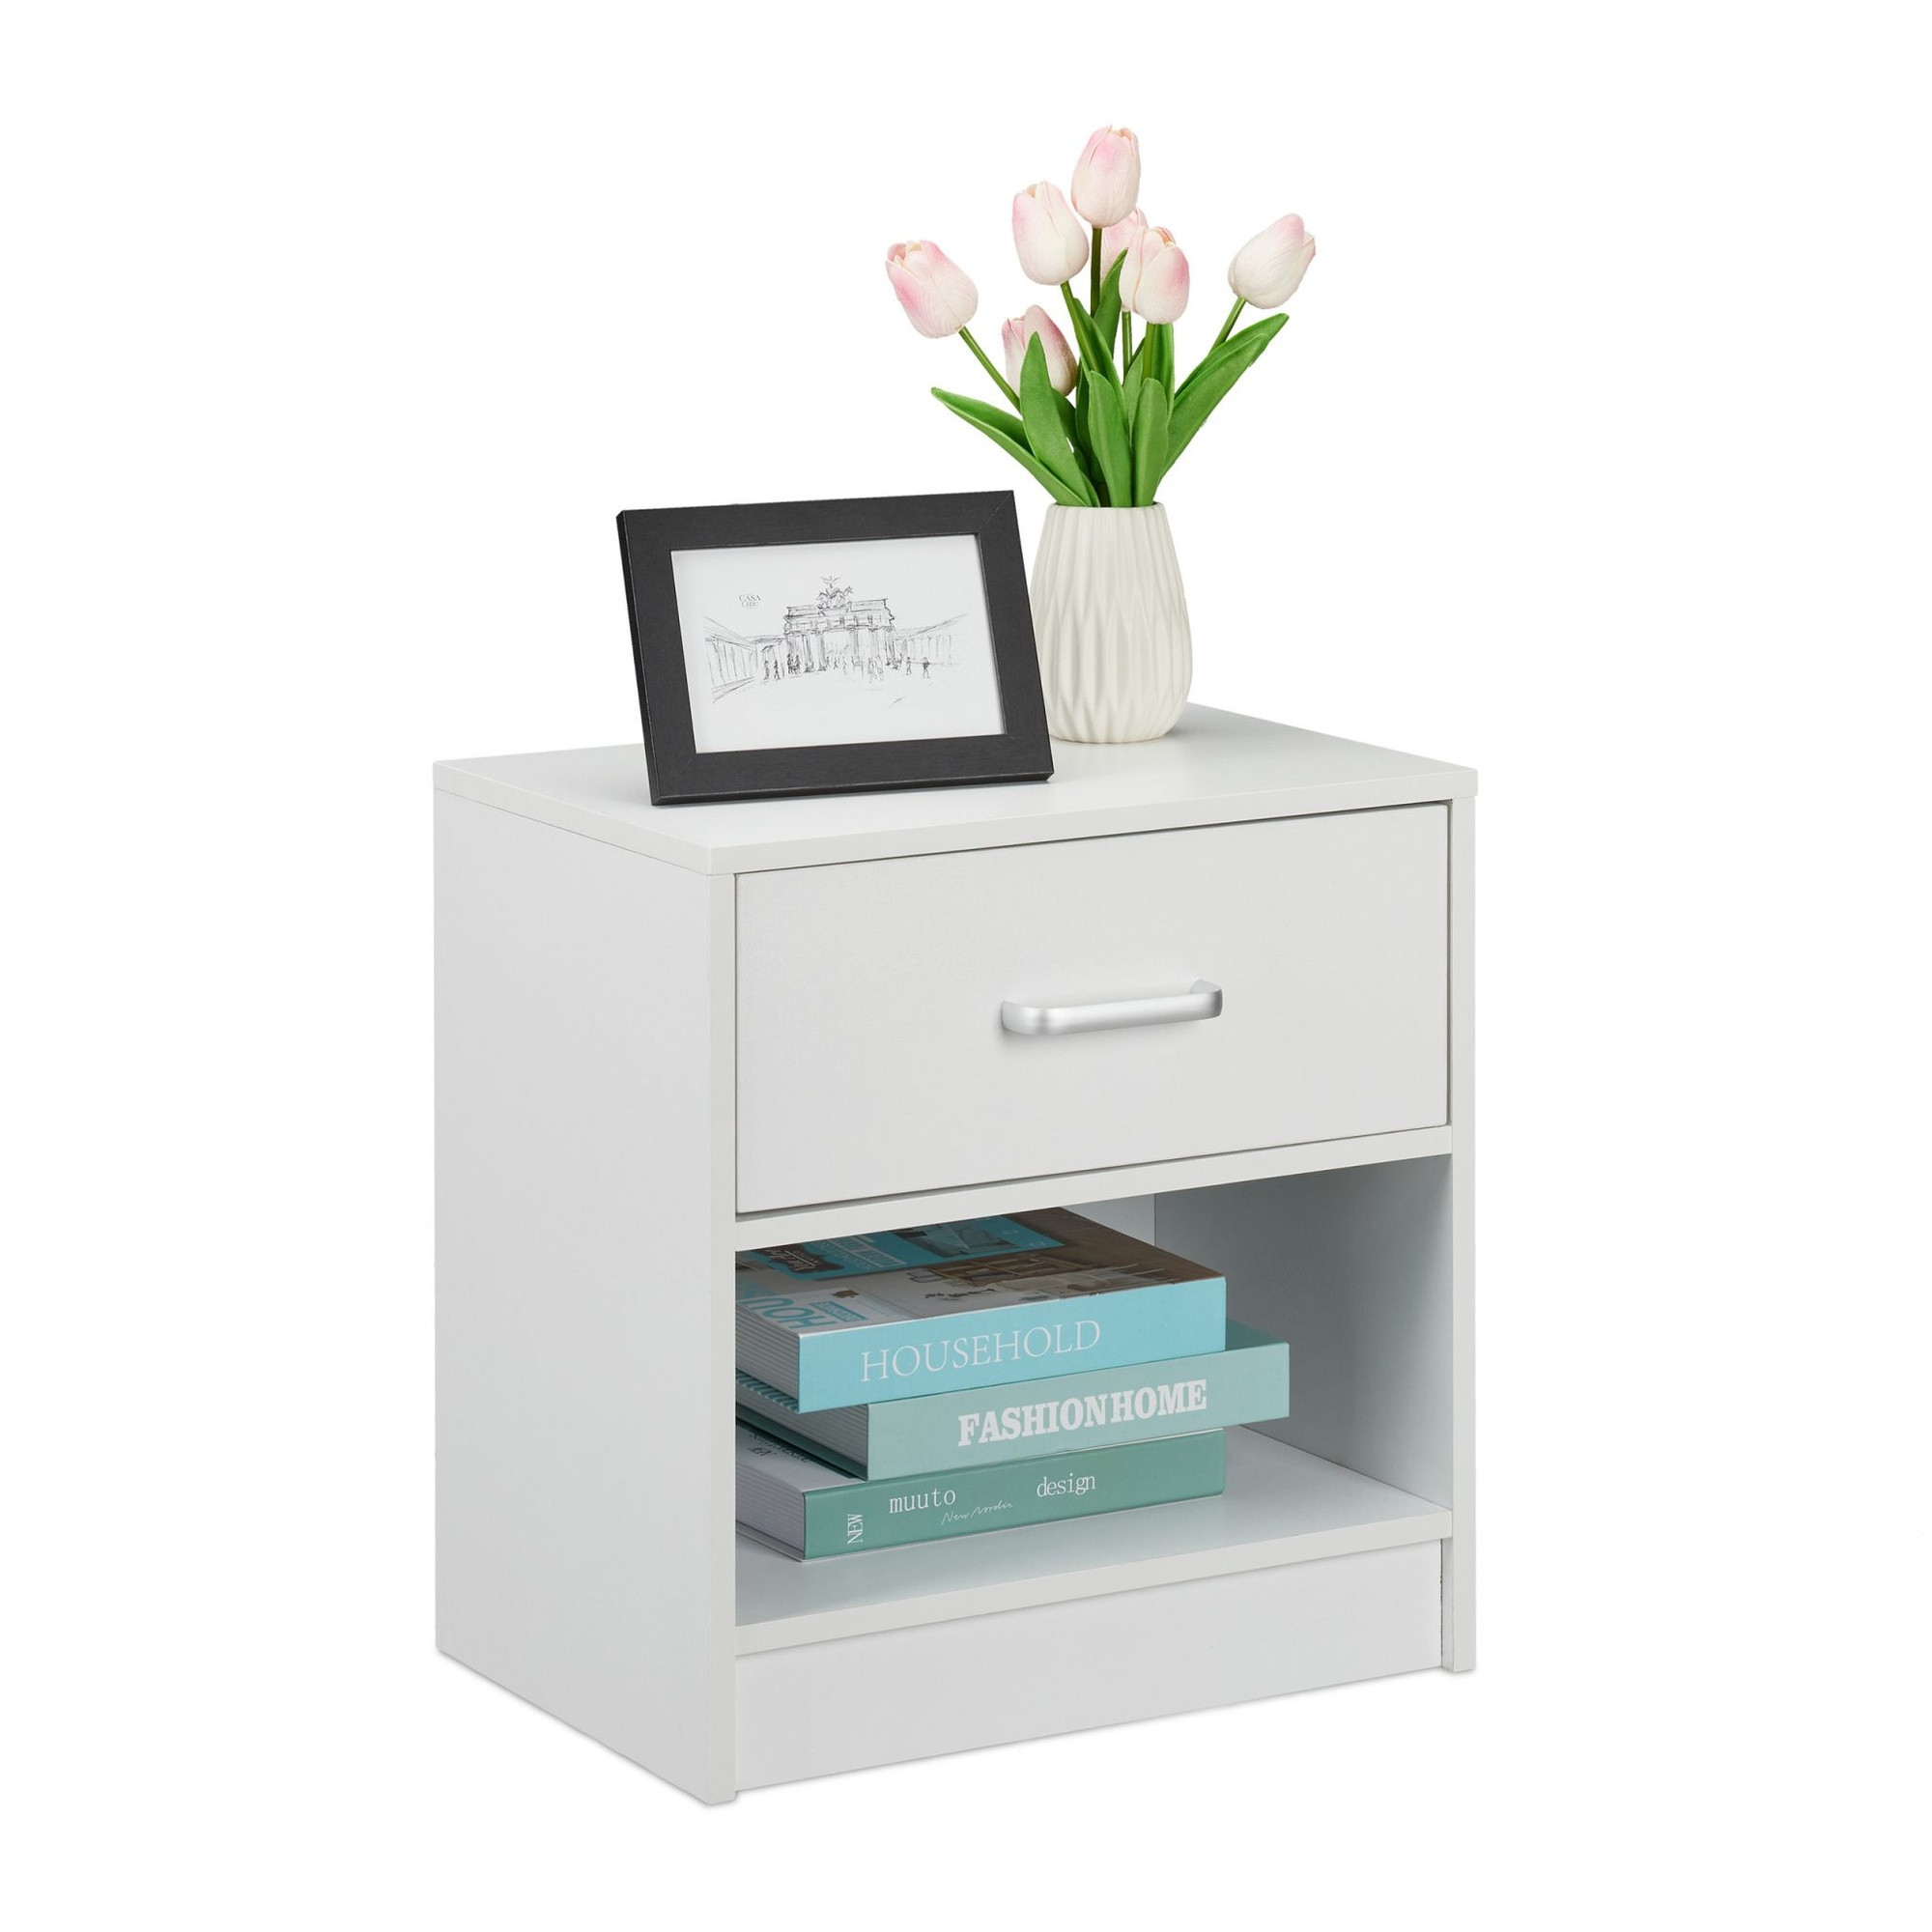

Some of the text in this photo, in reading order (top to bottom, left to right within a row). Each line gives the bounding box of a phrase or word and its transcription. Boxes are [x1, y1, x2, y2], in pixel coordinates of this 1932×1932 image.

[861, 1320, 1100, 1382] HOUSEHOLD
[889, 1472, 1096, 1514] muuto design
[847, 1513, 864, 1545] NEW
